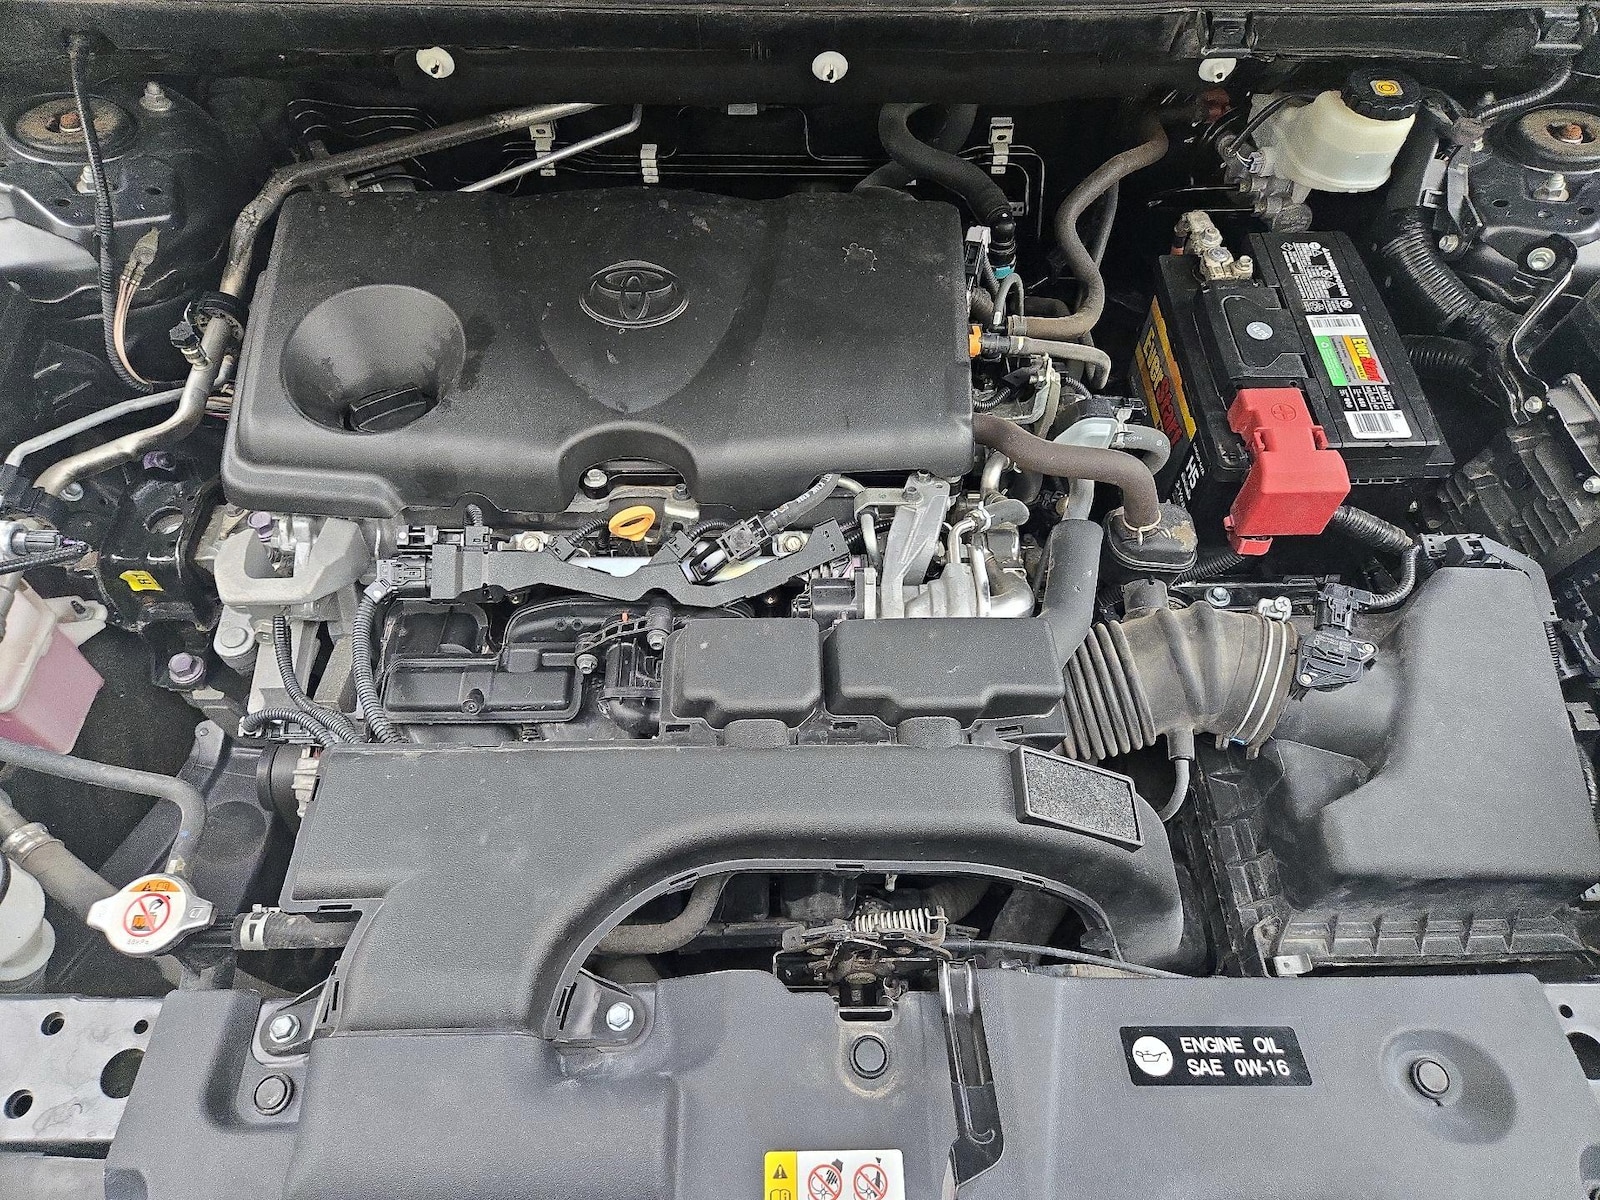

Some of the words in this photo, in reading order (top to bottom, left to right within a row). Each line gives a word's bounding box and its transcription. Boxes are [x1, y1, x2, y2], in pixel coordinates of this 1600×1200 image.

[1351, 338, 1383, 381] EverStart
[1143, 327, 1183, 447] EverStart
[1185, 455, 1200, 490] H5
[1179, 1036, 1245, 1053] ENGINE
[1252, 1036, 1284, 1053] OIL
[1186, 1059, 1225, 1076] SAE
[1233, 1059, 1291, 1076] 0W-16
